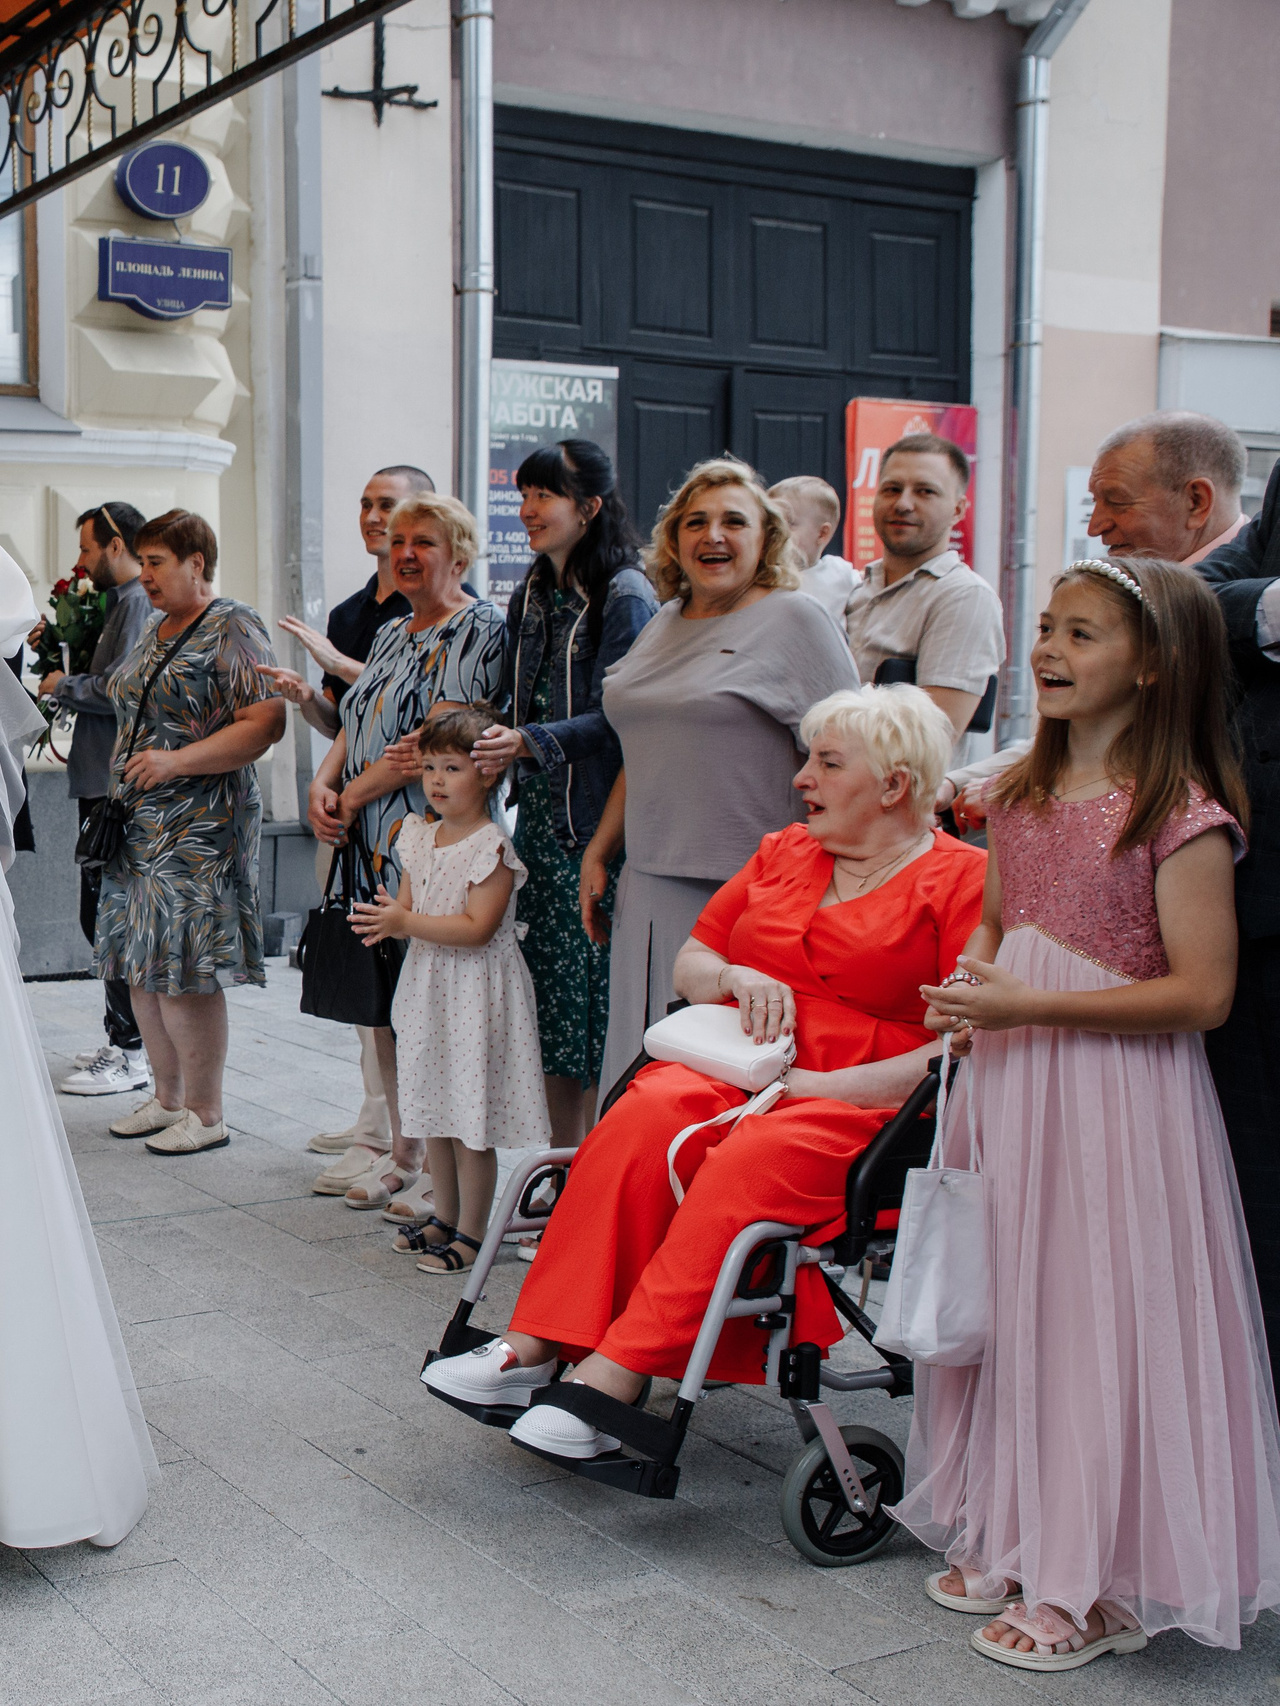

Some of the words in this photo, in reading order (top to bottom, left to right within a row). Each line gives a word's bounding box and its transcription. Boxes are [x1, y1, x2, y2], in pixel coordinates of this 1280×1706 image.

[155, 163, 181, 196] 11
[115, 260, 175, 277] ПЛОЩАДЬ
[177, 267, 225, 282] ЛЕНИНА
[491, 402, 579, 430] АБОТА
